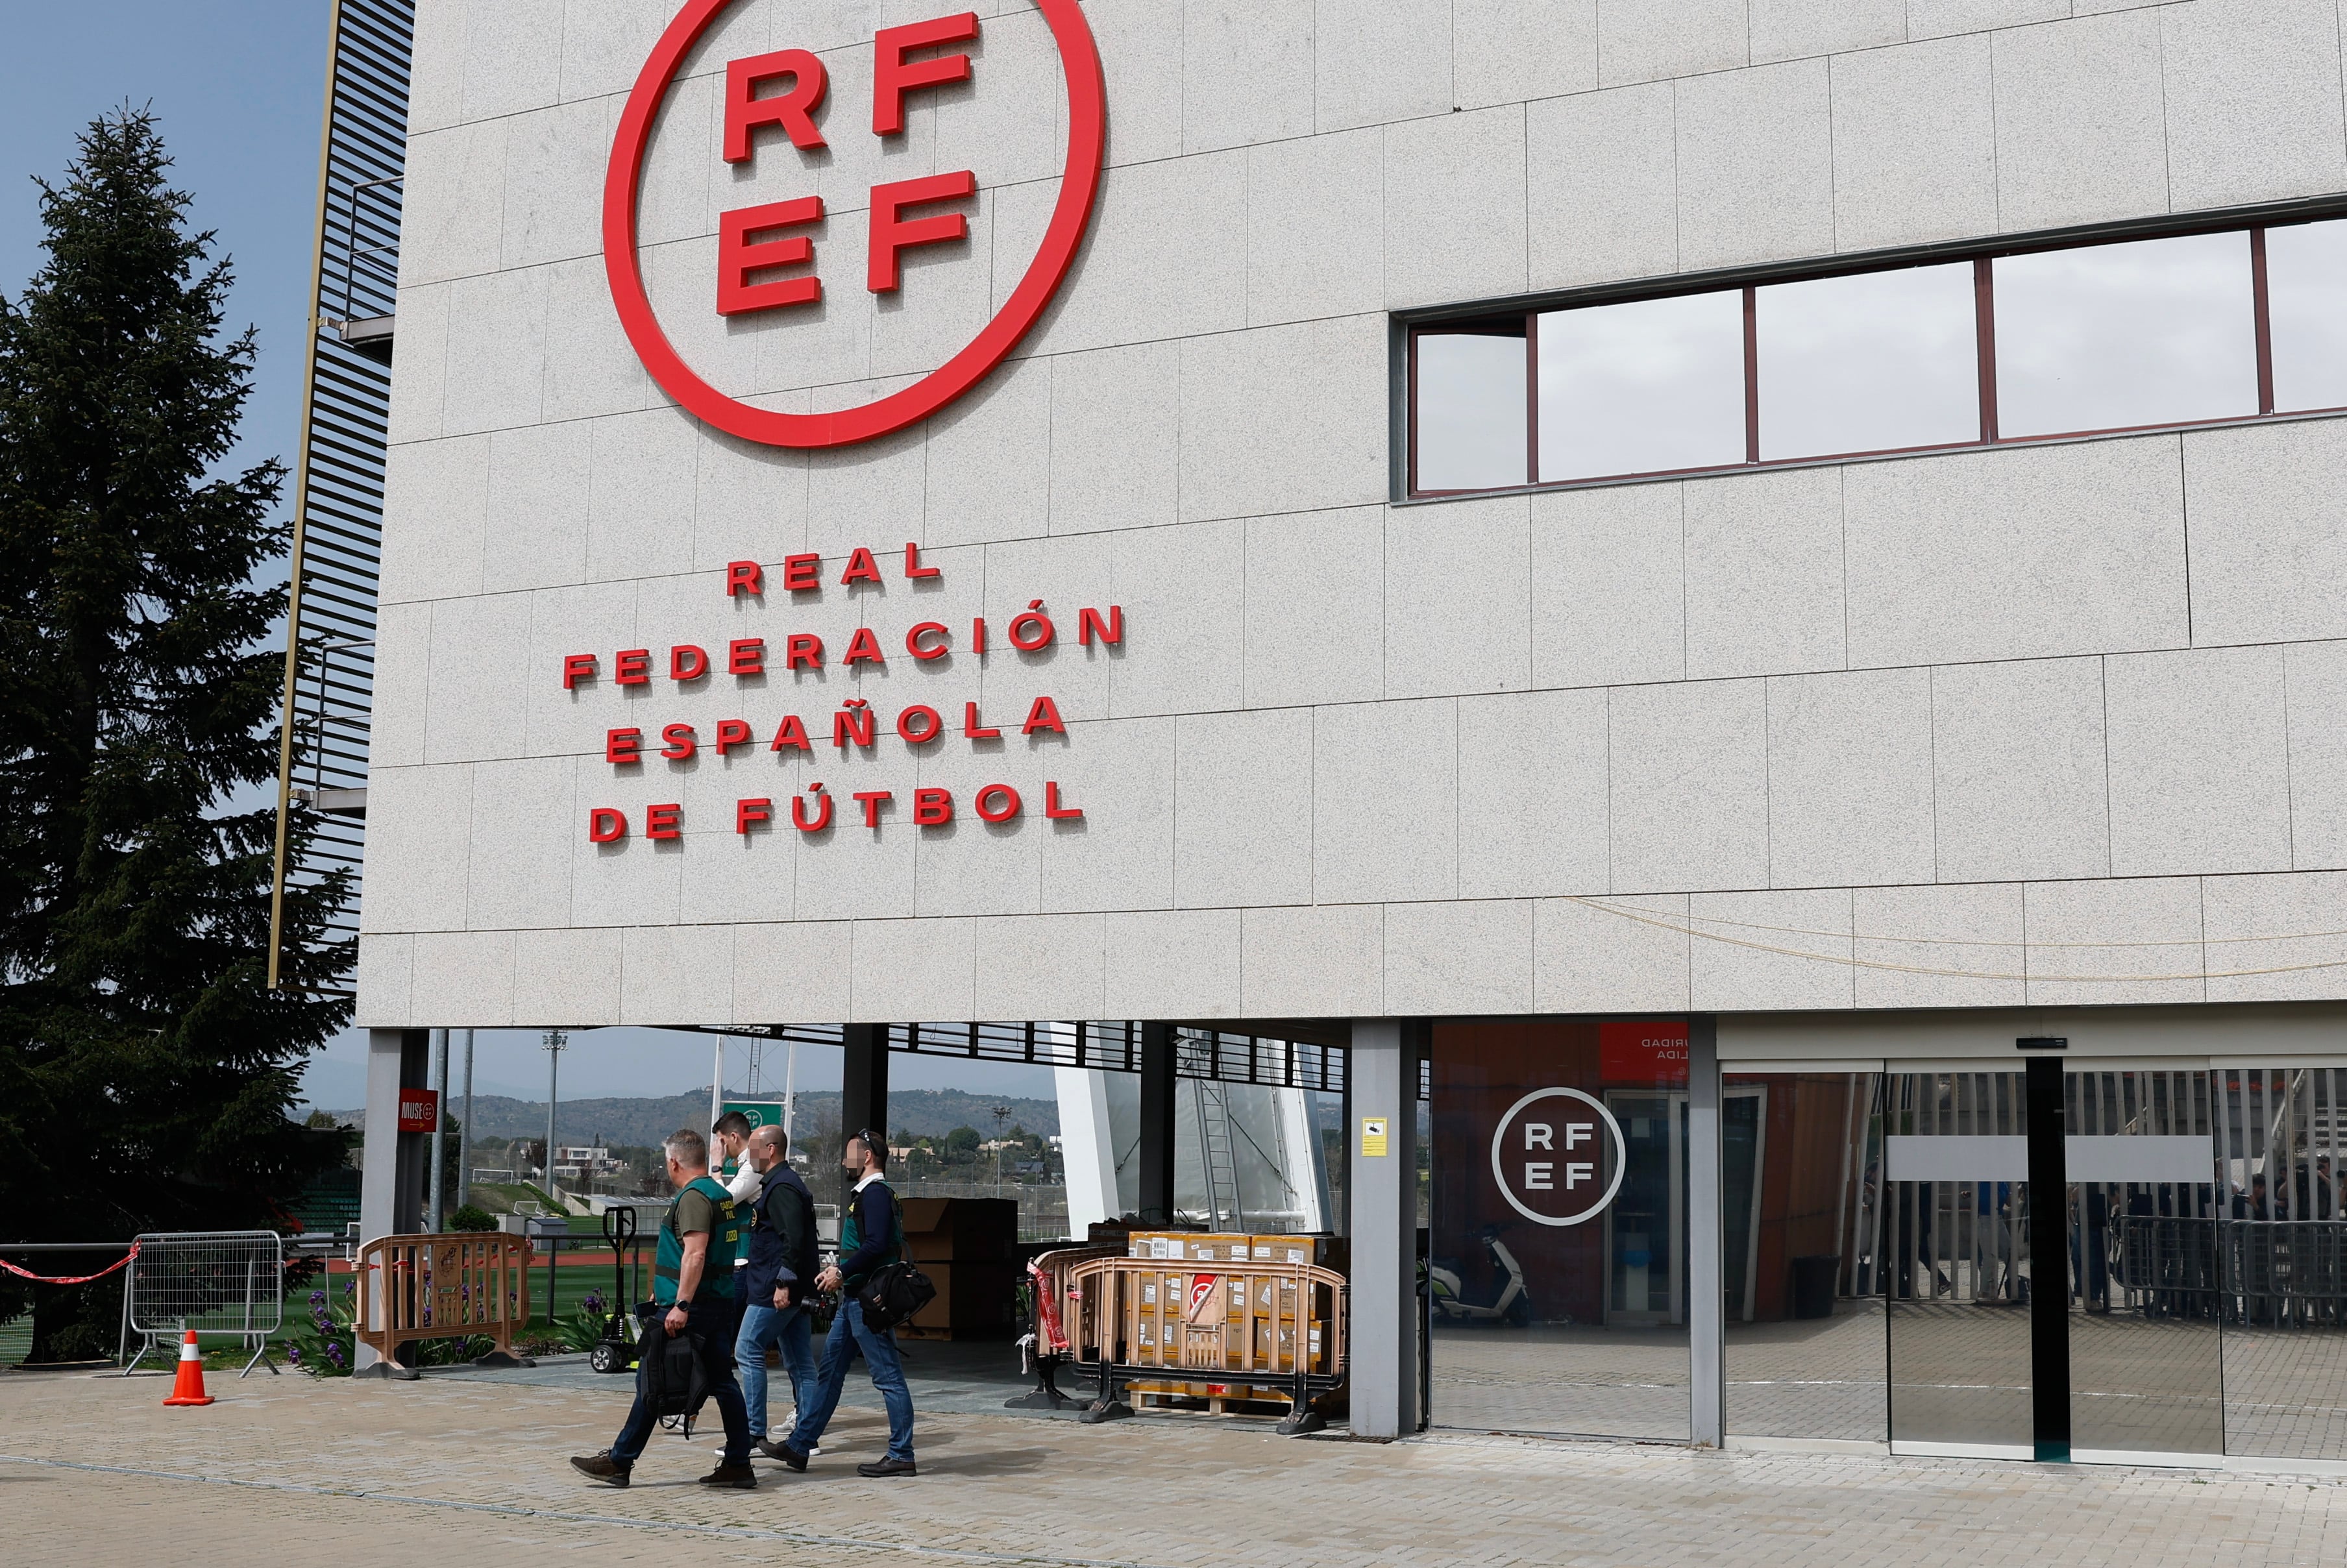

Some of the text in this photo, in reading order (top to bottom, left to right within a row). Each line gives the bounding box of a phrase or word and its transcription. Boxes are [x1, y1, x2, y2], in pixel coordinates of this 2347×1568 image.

[726, 542, 940, 597] REAL
[563, 598, 1122, 690] FEDERACIÓN
[606, 696, 1066, 764] ESPAÑOLA
[589, 781, 1083, 843] DE FÚTBOL
[726, 1210, 735, 1220] IVIL
